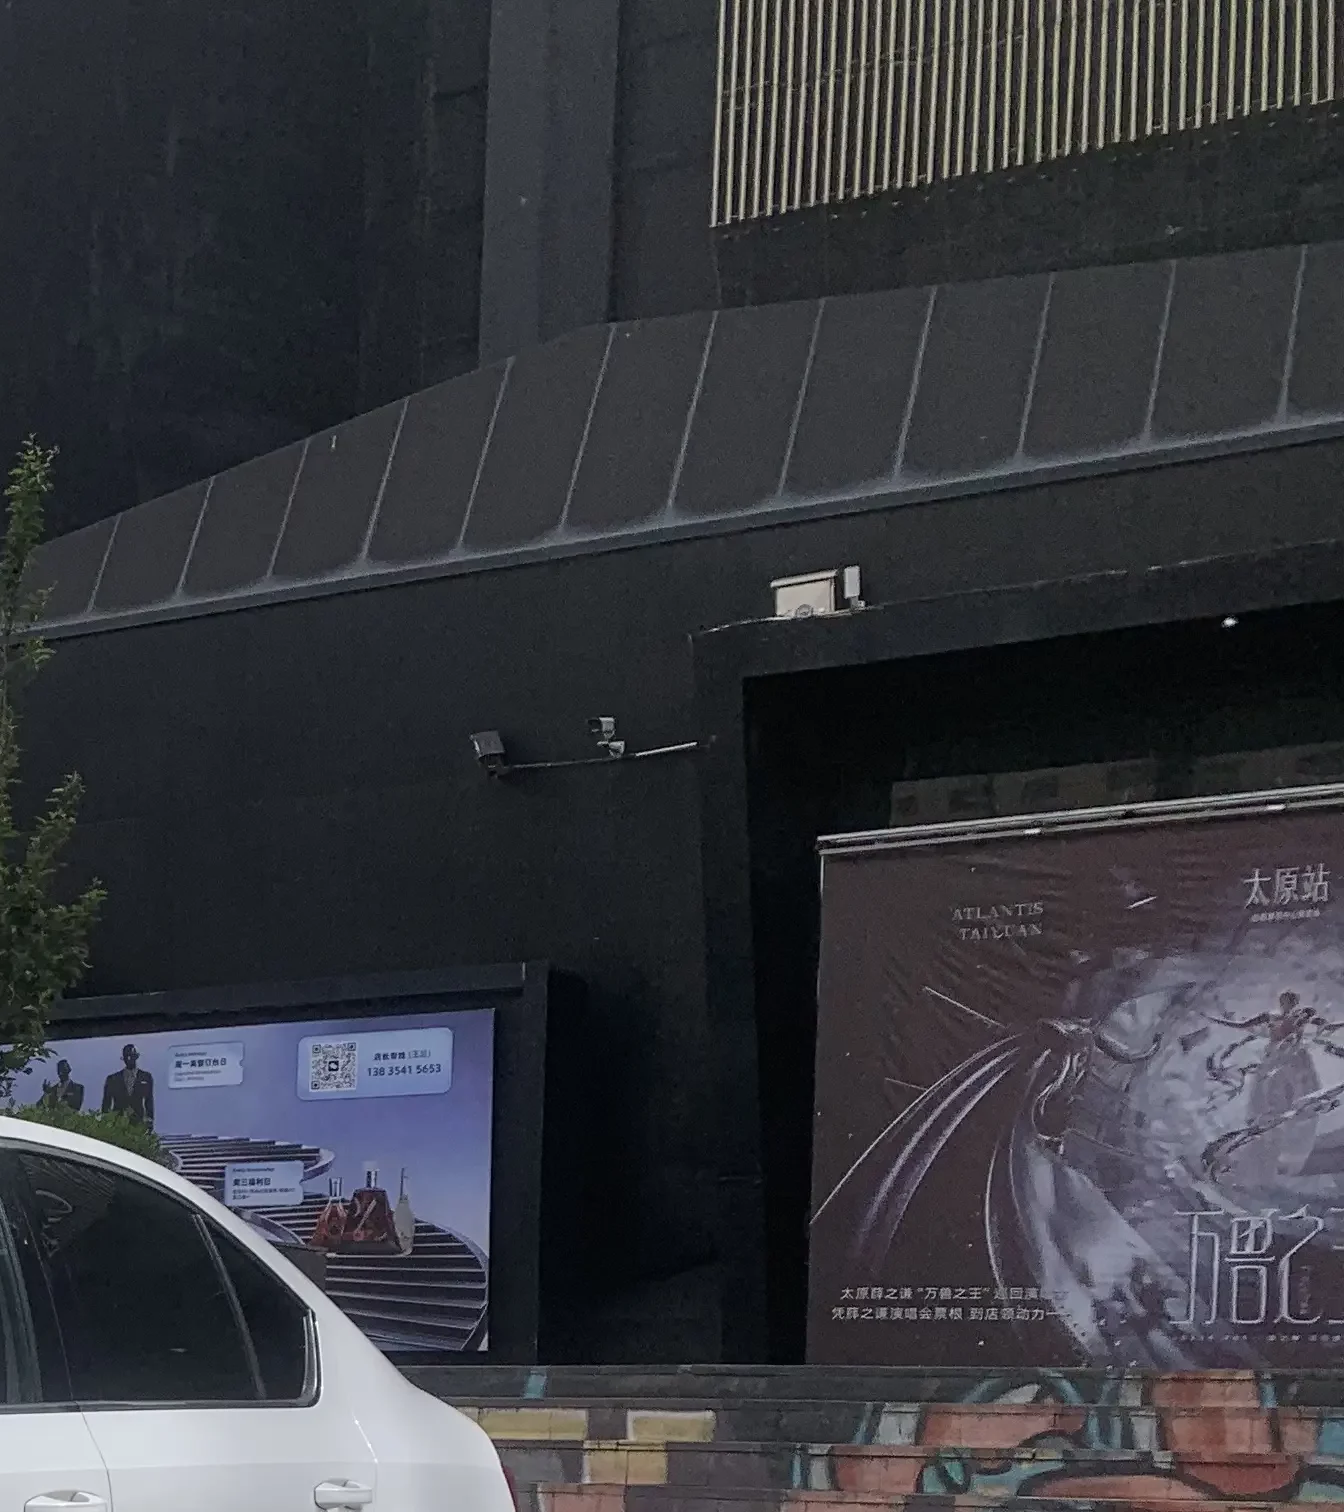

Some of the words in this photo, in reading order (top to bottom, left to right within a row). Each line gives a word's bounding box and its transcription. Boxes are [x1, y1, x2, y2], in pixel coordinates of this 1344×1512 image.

[1243, 862, 1331, 909] 太原站
[952, 902, 1044, 920] ATLANTIS
[367, 1067, 385, 1076] 138
